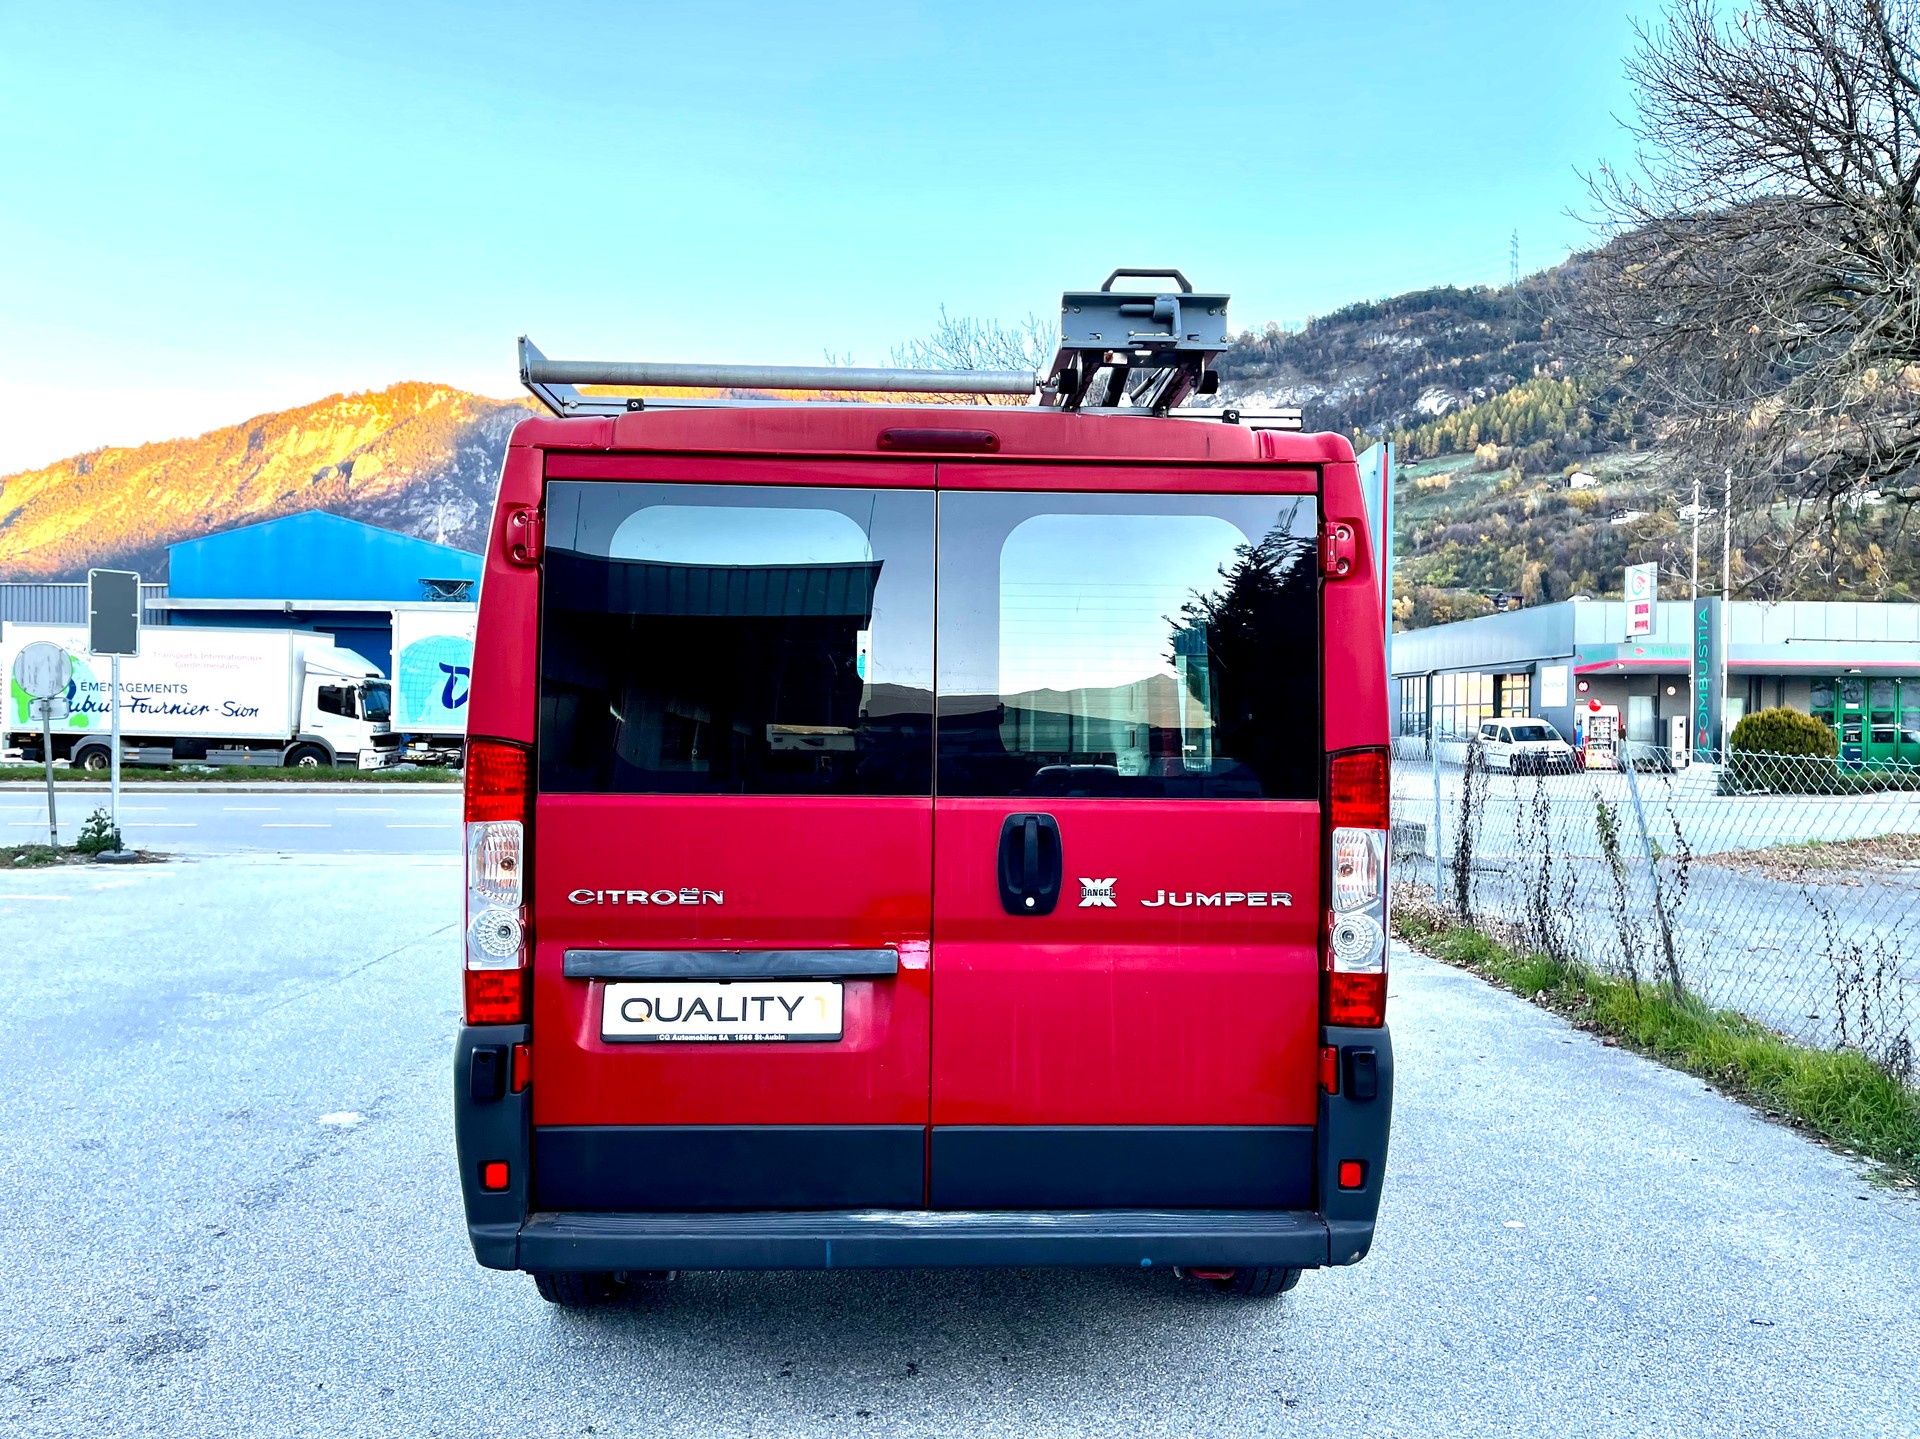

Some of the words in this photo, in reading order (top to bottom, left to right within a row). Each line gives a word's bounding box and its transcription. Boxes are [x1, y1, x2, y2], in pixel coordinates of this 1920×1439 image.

[1696, 607, 1711, 754] COMBUSTIA
[221, 701, 259, 718] Sion
[567, 887, 724, 905] CITROËN
[1080, 887, 1116, 898] DANGEL
[620, 995, 805, 1022] QUALITY
[672, 1033, 717, 1041] Automobiles
